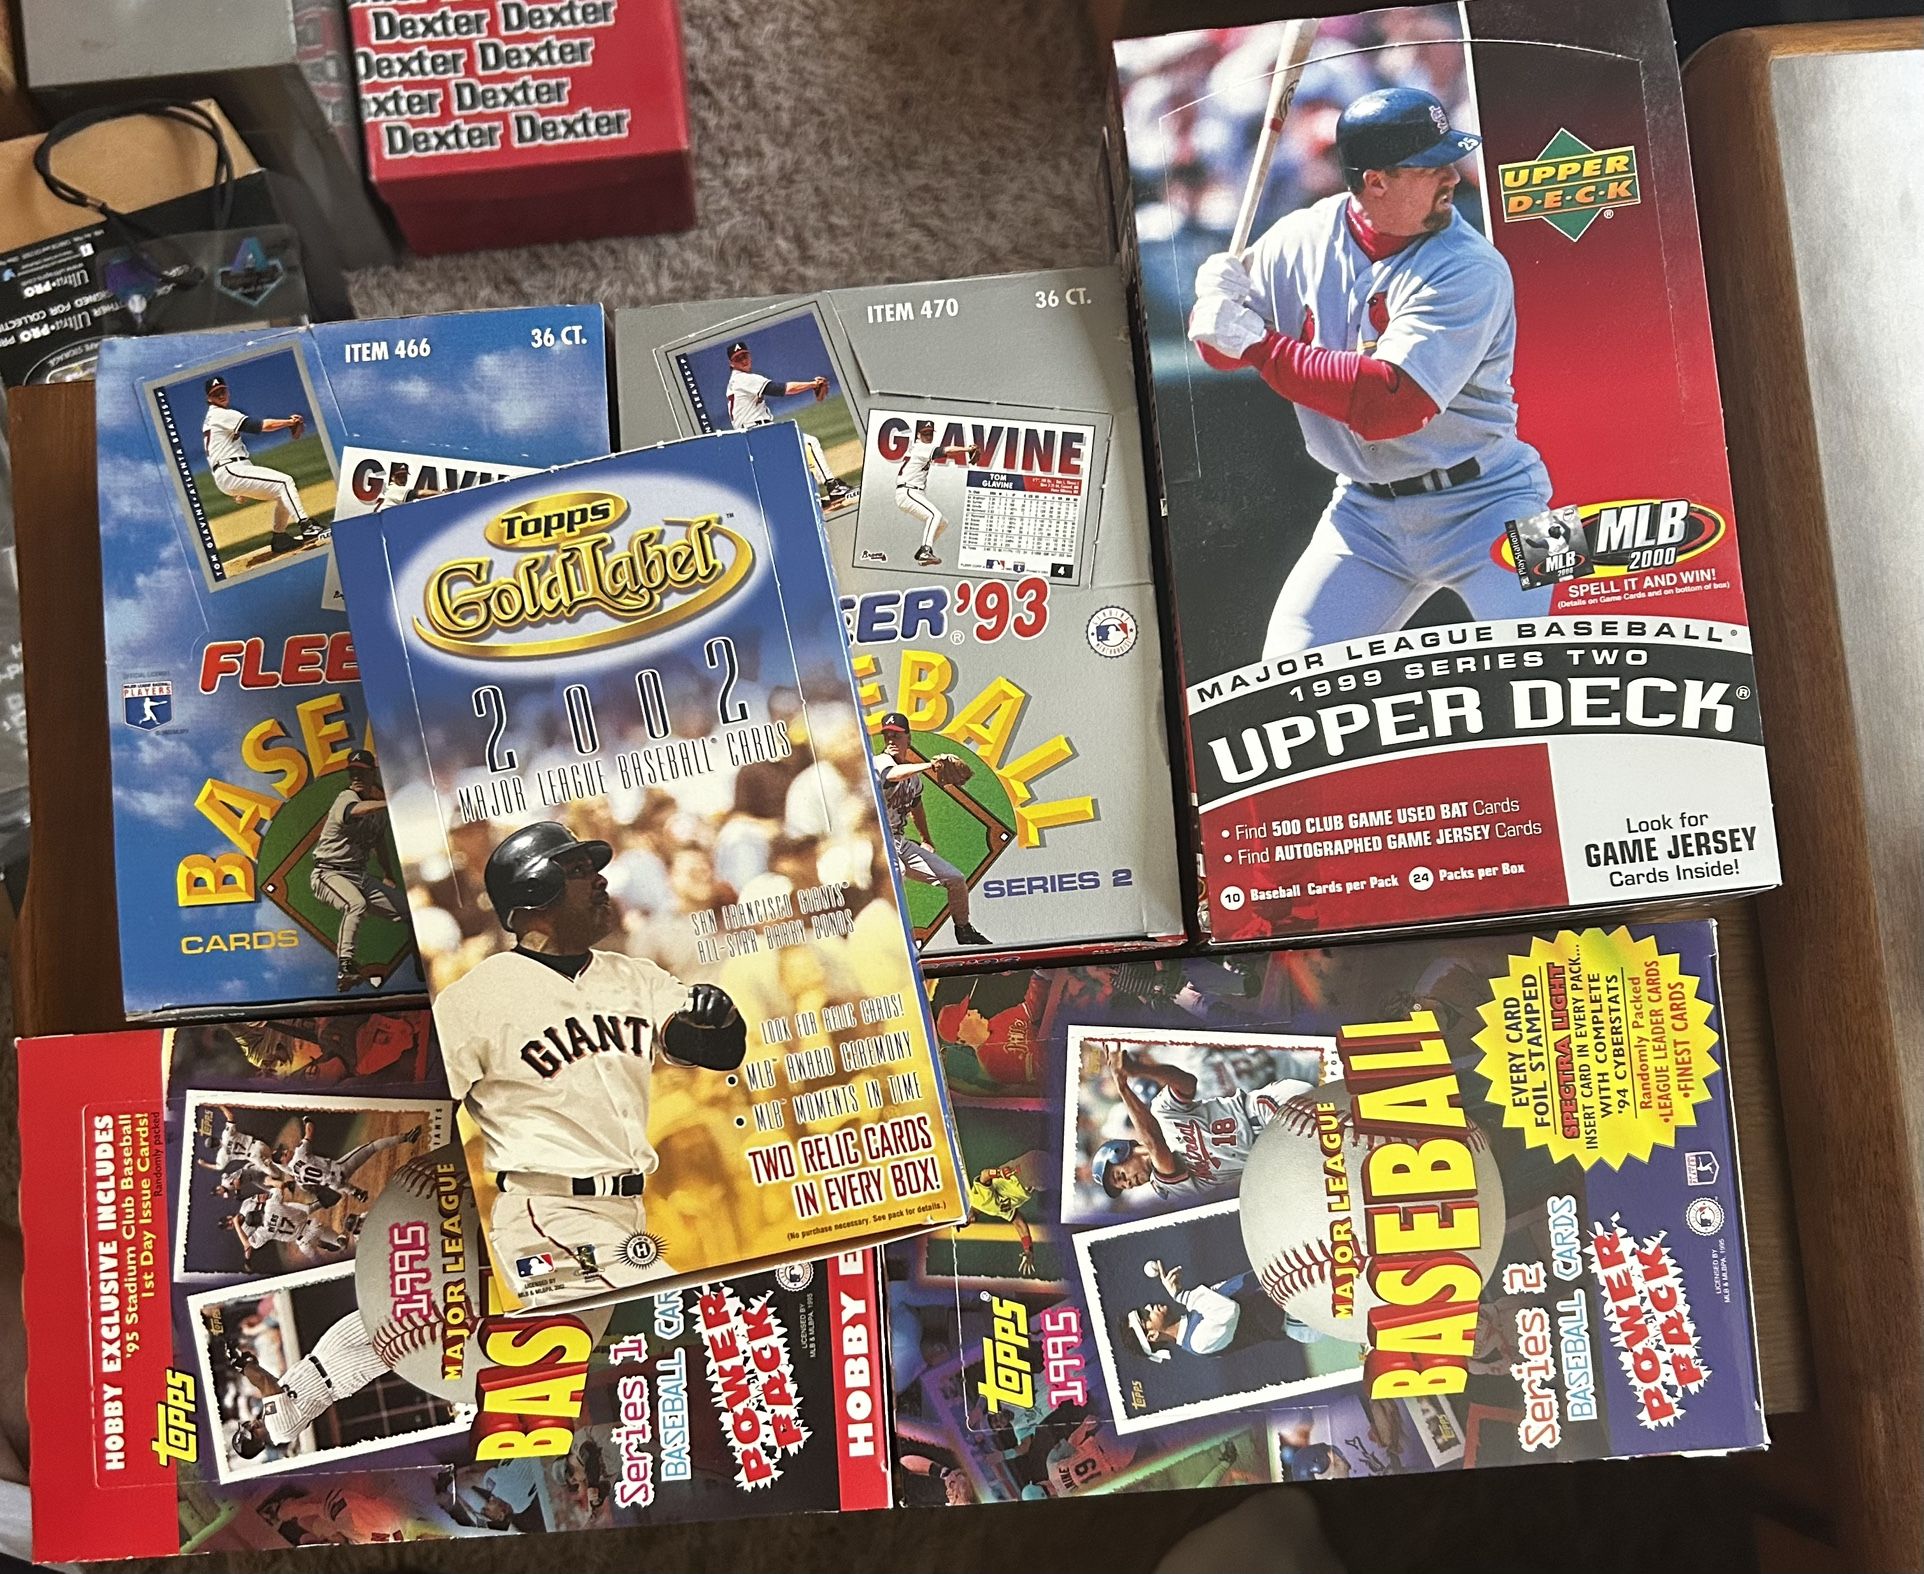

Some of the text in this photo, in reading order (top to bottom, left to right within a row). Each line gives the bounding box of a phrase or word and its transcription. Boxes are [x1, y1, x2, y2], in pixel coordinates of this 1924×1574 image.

[371, 0, 617, 43] Dexter Dexter
[476, 38, 593, 73] Dexter
[452, 77, 570, 114] Dexter
[1458, 137, 1478, 151] 25
[1504, 154, 1631, 188] UPPER
[867, 288, 1092, 323] ITEM 470 36 CT.
[345, 325, 587, 363] ITEM 466 36 CT.
[501, 501, 611, 541] Topps
[1597, 500, 1689, 553] MLB
[1546, 551, 1577, 572] MLB
[1568, 568, 1716, 598] SPELL IT AND WIN!
[1630, 548, 1676, 570] 2000
[1558, 599, 1586, 609] (Details
[1600, 594, 1621, 603] Game
[1623, 591, 1646, 600] Cards
[1648, 588, 1662, 596] and
[1675, 585, 1702, 594] bottom
[1704, 583, 1712, 591] of
[1713, 581, 1730, 590] box)
[1196, 620, 1724, 704] MAJOR LEAGUE BASEBALL
[1289, 649, 1648, 702] 1999 SERIES TWO
[1207, 677, 1734, 784] UPPER DECK
[458, 721, 793, 824] MAJOR LEAGUE BASEBALL CARDS
[1235, 797, 1520, 841] Find 500 CLUB GAME USED BAT Cards
[1237, 820, 1542, 865] Find AUTOGRAPHED GAME JERSEY Cards
[1626, 812, 1708, 834] Look for
[1585, 826, 1757, 868] GAME JERSEY
[1609, 858, 1740, 888] Cards Inside!
[983, 869, 1132, 899] SERIES 2
[1224, 862, 1525, 903] 10 Baseball Cards per Pack 24 Packs per Box
[691, 884, 846, 936] SAN FRANCISCO GIANTS
[697, 909, 855, 964] ALL-STAR BARRY BONDS
[181, 930, 298, 955] CARDS
[1644, 961, 1662, 1008] CARDS
[1668, 982, 1689, 1034] CARDS
[761, 994, 905, 1045] LOOK FOR RELIC CARDS!
[1587, 973, 1613, 1119] WITH COMPLETE
[1606, 974, 1631, 1115] '94 CYBERSTATS
[1628, 976, 1653, 1109] Randomly Packed
[1650, 1012, 1668, 1059] LEADER
[520, 1014, 650, 1079] GIANT
[746, 1031, 913, 1090] MLB AWARD CEREMONY
[1503, 996, 1529, 1107] EVERY CARD
[1522, 974, 1551, 1127] FOIL STAMPED
[1547, 962, 1580, 1139] SPECTRA LIGHT
[1572, 998, 1598, 1150] INSERT CARD IN EVERY
[754, 1072, 922, 1132] MLB MOMENTS IN TIME
[153, 1111, 163, 1197] Randomly packed
[748, 1116, 932, 1184] TWO RELIC CARDS
[1210, 1117, 1238, 1148] 18
[135, 1113, 156, 1298] 1st Day Issue Cards!
[794, 1157, 941, 1217] IN EVERY BOX!
[1338, 1009, 1483, 1400] BASEBALL
[118, 1114, 140, 1358] '95 Stadium Club Baseball
[787, 1200, 947, 1242] (No purchase necessary. See pack for details.)
[94, 1115, 125, 1470] HOBBY EXCLUSIVE INCLUDES
[390, 1222, 431, 1321] 1995
[1593, 1231, 1675, 1421] POWER
[1636, 1243, 1704, 1387] PACK
[661, 1350, 688, 1478] BASEBALL
[616, 1378, 652, 1505] Series
